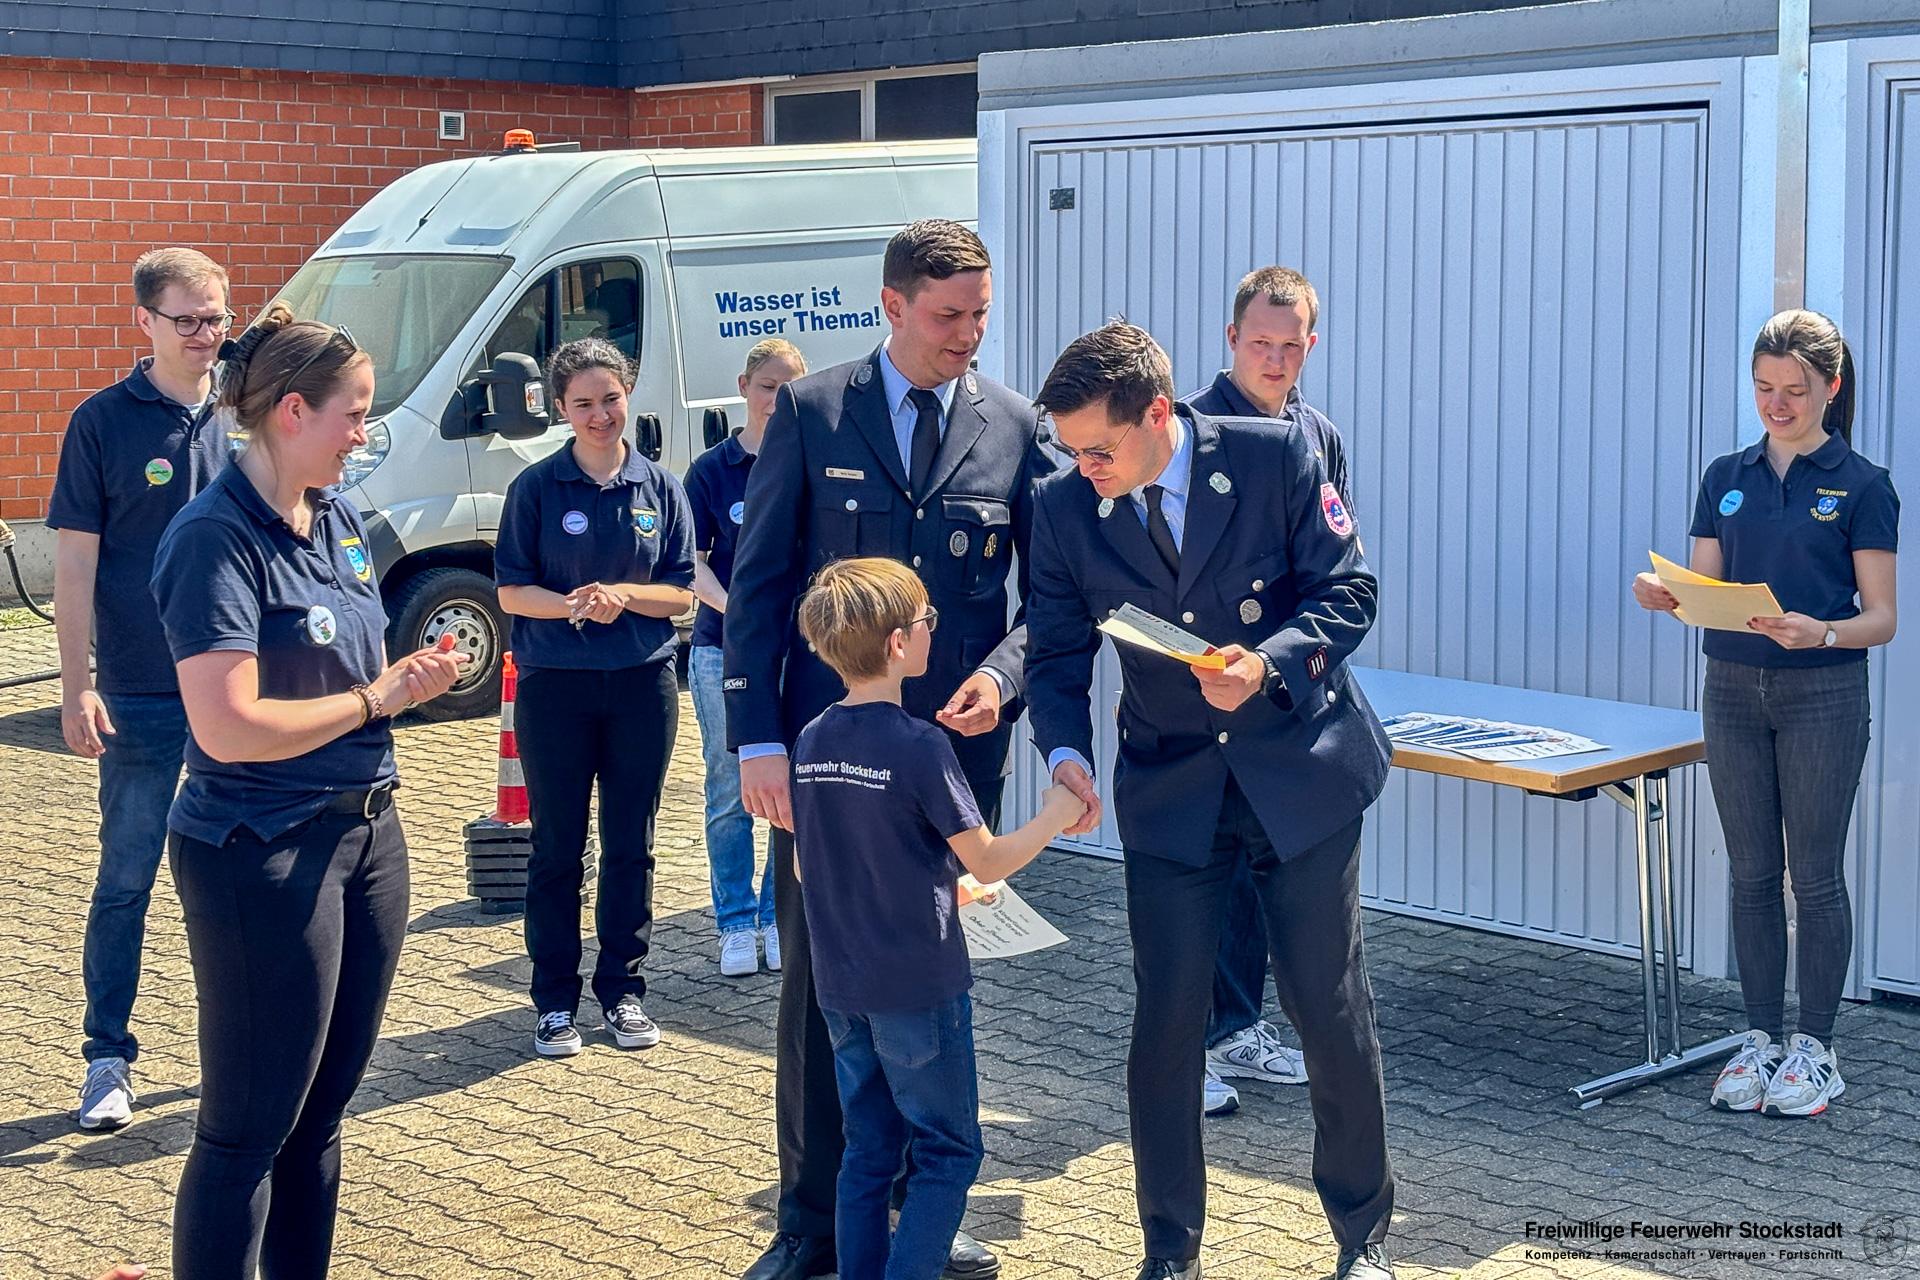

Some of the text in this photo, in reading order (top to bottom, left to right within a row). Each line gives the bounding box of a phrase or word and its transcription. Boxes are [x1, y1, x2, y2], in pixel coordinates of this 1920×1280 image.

[715, 285, 842, 314] Wasser ist
[719, 306, 881, 338] unser Thema!
[795, 760, 891, 781] Feuerwehr Stockstadt
